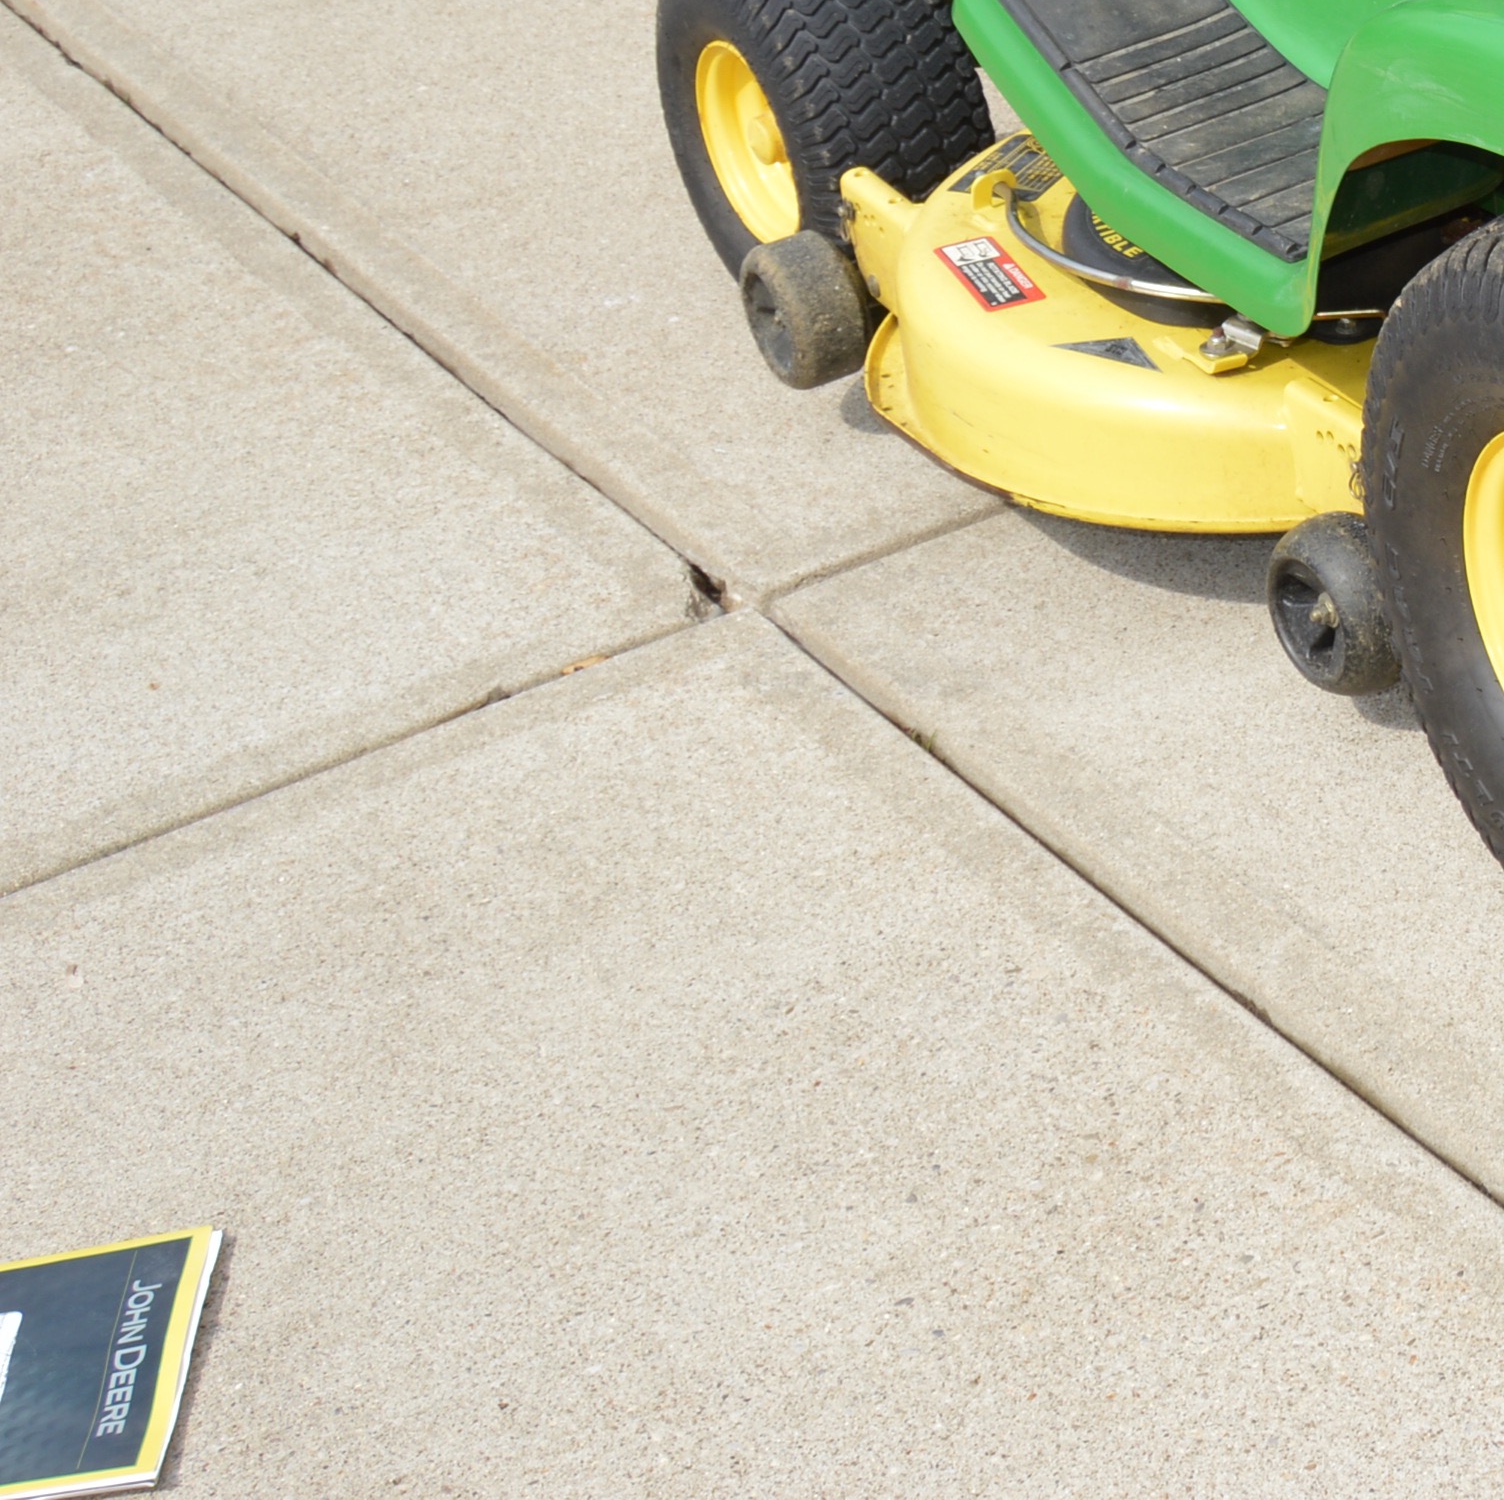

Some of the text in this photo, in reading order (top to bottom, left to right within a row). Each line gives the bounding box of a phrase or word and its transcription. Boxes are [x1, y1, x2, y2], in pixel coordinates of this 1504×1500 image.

[1009, 266, 1034, 290] DANGER
[96, 1279, 163, 1438] JOHN DEERE
